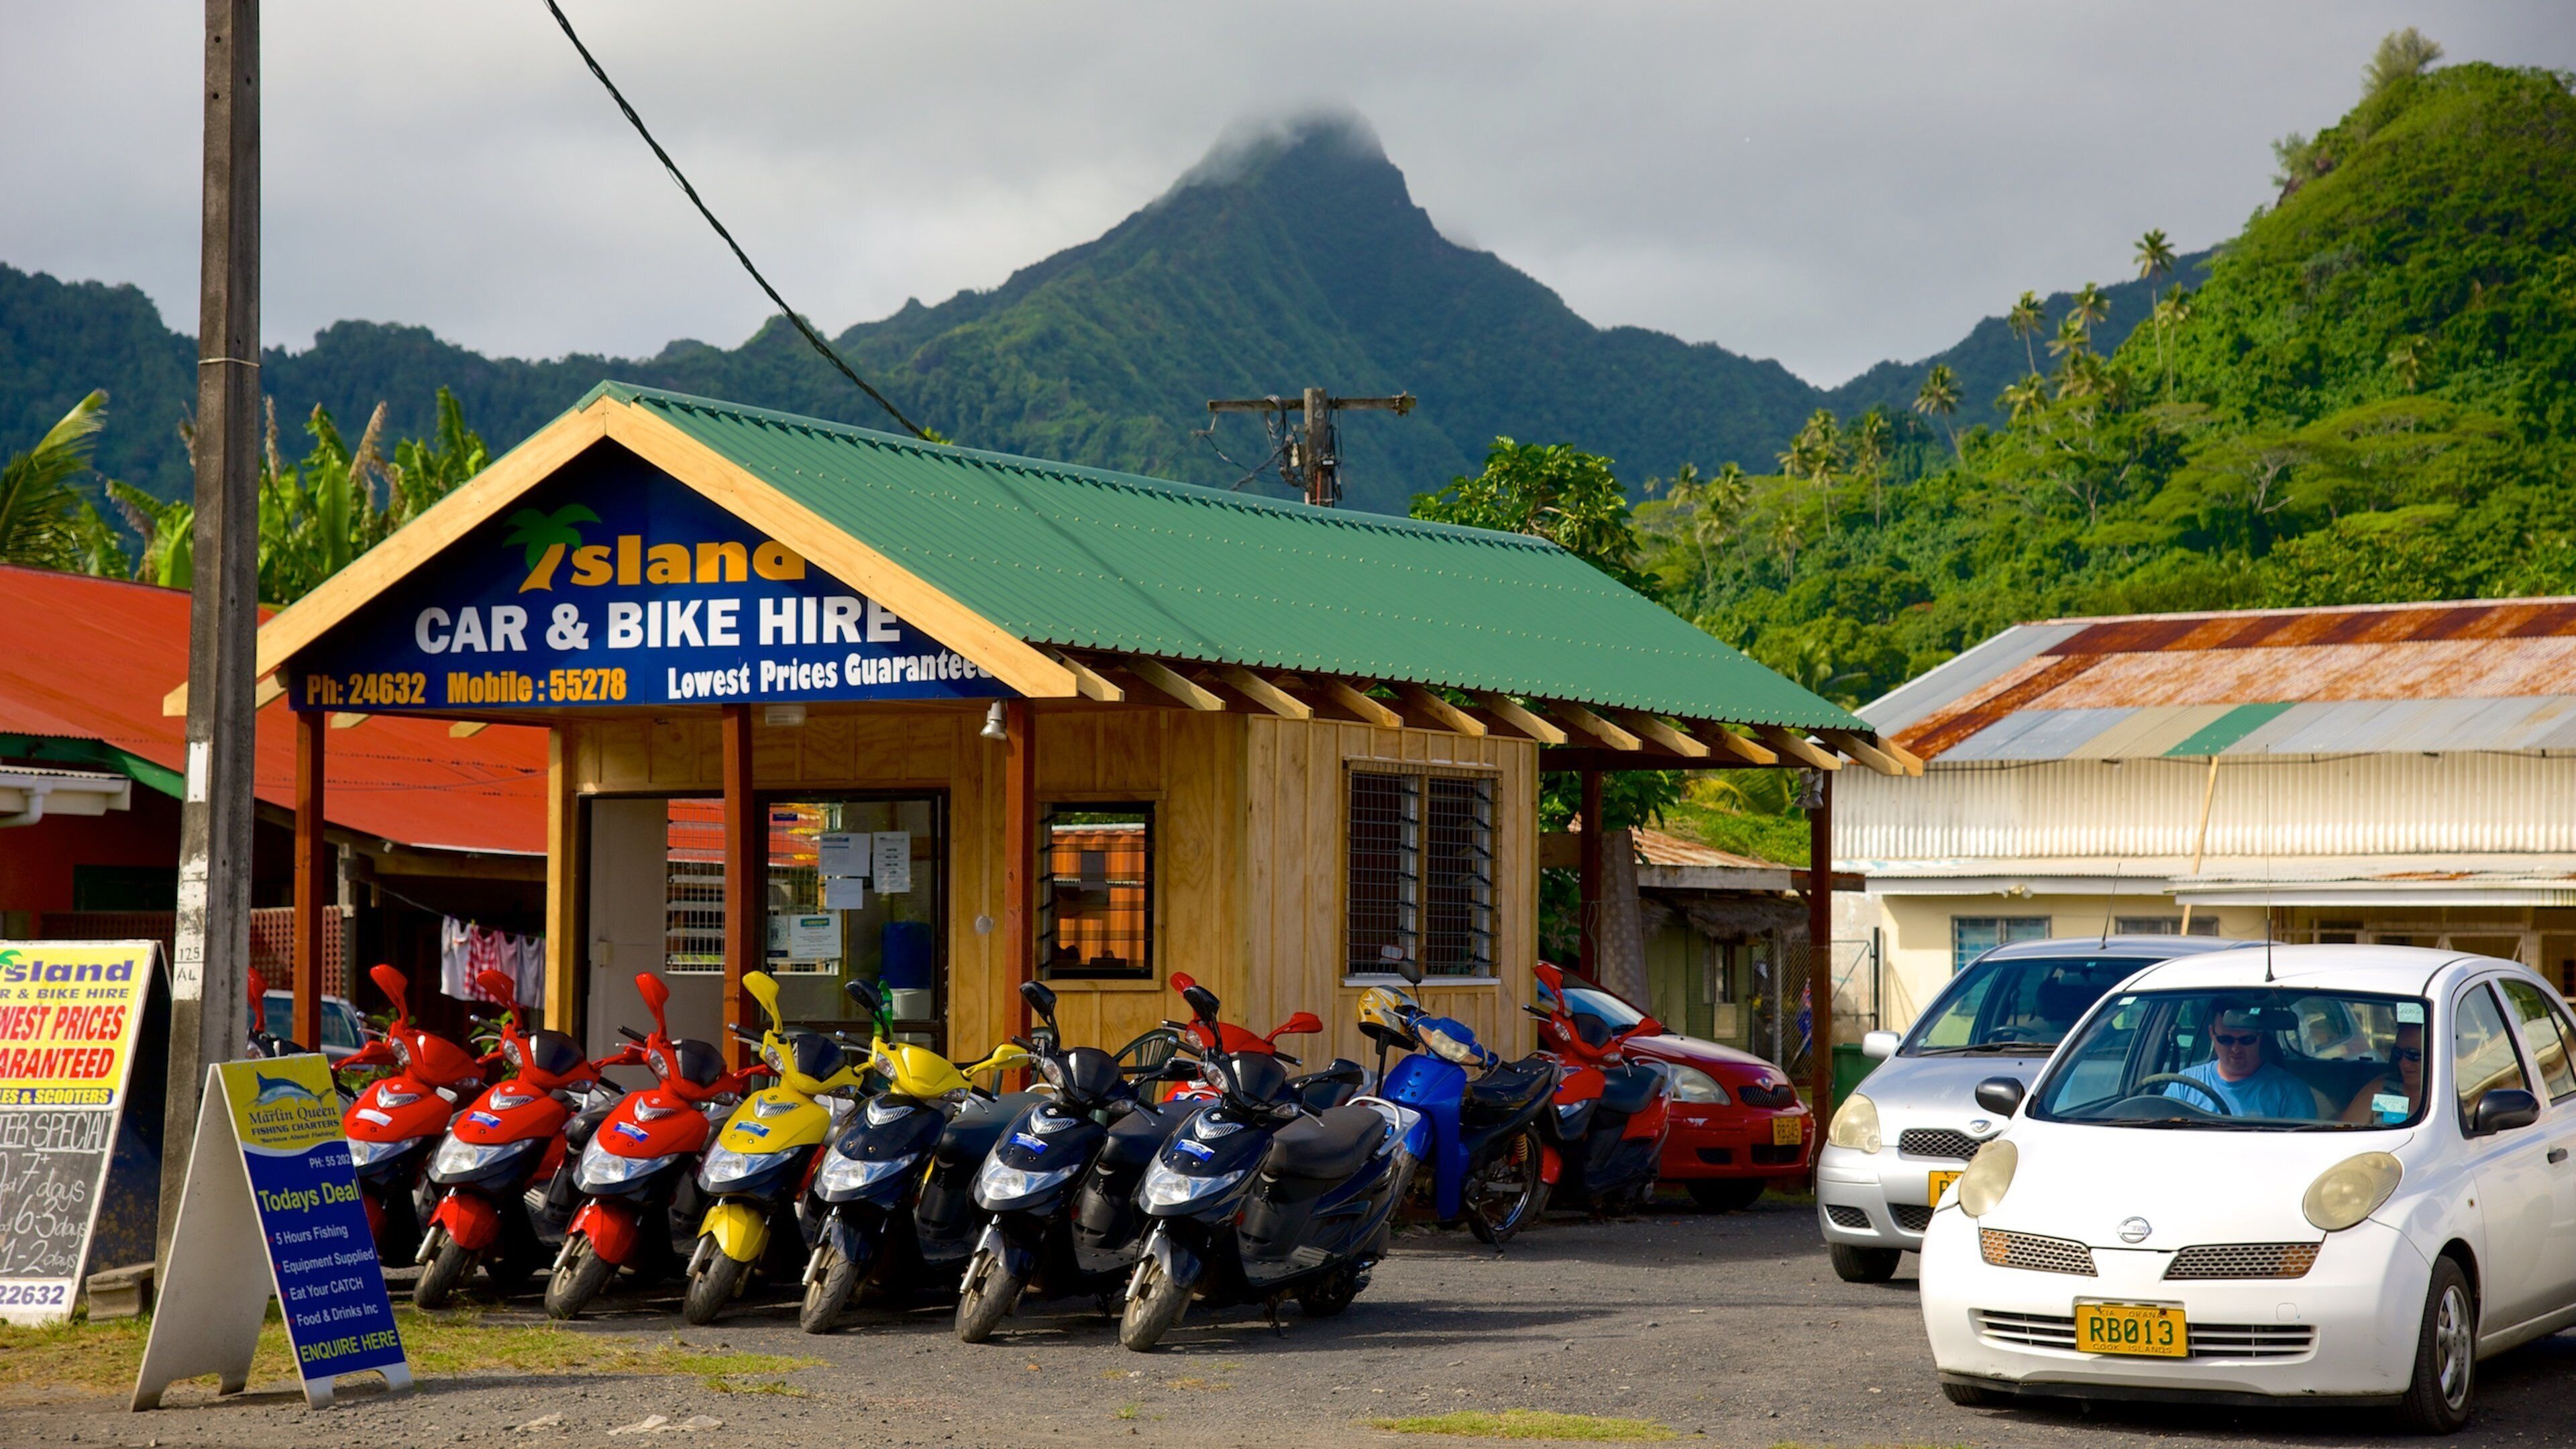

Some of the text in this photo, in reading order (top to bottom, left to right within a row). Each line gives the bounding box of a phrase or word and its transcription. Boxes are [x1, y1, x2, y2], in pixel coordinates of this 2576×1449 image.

[415, 596, 900, 654] CAR & BIKE HIRE
[307, 674, 343, 705] Ph:
[349, 672, 426, 704] 24632
[549, 667, 627, 702] 55278
[668, 663, 750, 700] Lowest
[760, 657, 838, 693] Prices
[17, 988, 30, 999] &
[37, 988, 80, 999] BIKE
[86, 988, 129, 999] HIRE
[50, 1004, 126, 1041] PRICES
[20, 1090, 32, 1104] &
[34, 1088, 109, 1104] SCOOTERS
[248, 1106, 337, 1124] Marlin Queen
[252, 1120, 339, 1136] FISHING CHARTERS
[32, 1112, 107, 1151] SPECIAL
[1777, 1124, 1799, 1139] RB345
[309, 1157, 325, 1169] PH:
[36, 1167, 85, 1212] days
[258, 1179, 360, 1214] Todays Deal
[275, 1224, 349, 1245] 5 Hours Fishing
[282, 1247, 375, 1275] Equipment Supplied
[289, 1277, 364, 1301] Eat Your CATCH
[296, 1303, 378, 1327] Food & Drinks Inc
[2090, 1316, 2174, 1346] RB013
[300, 1330, 398, 1362] ENQUIRE HERE
[2092, 1343, 2172, 1354] COOK ISLANDS
